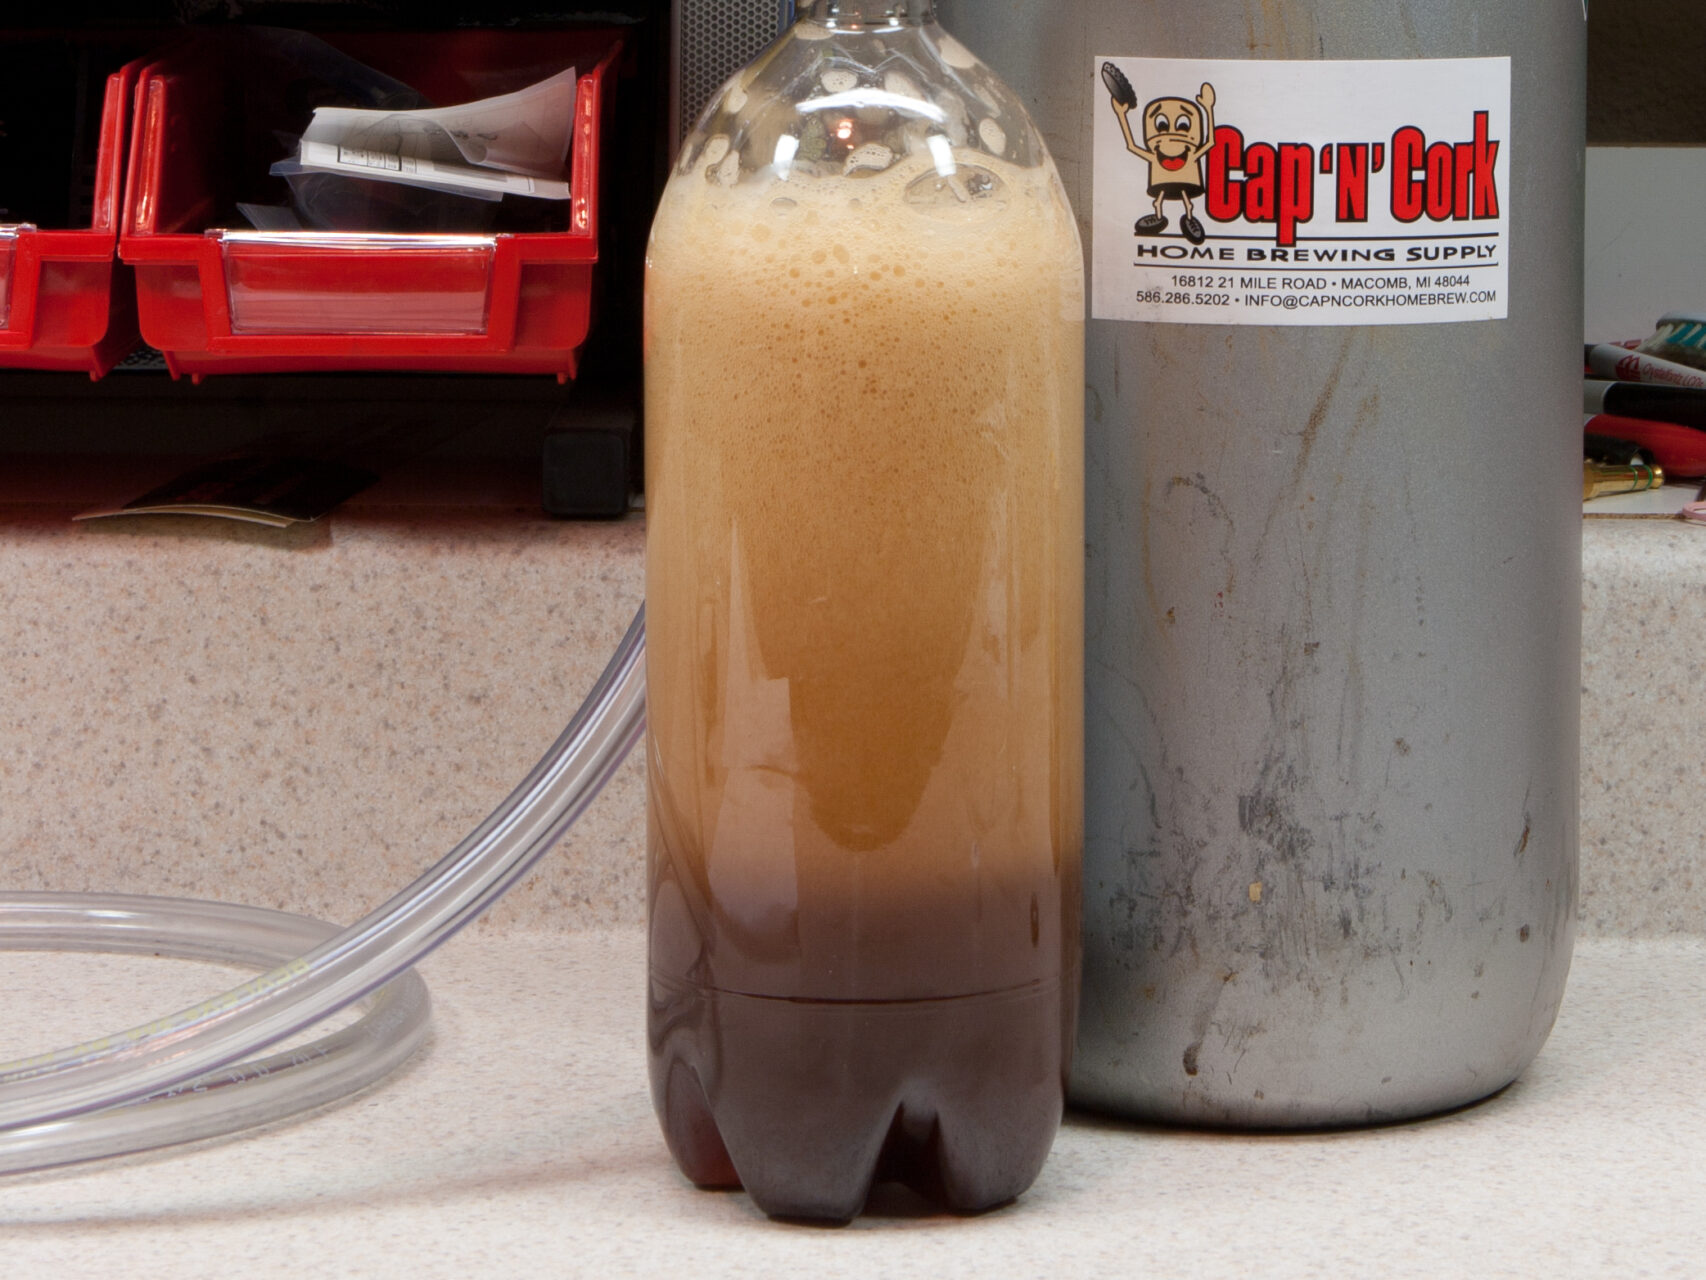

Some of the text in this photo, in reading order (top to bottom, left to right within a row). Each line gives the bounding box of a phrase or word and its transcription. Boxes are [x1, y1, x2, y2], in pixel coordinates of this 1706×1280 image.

[1205, 124, 1315, 248] Cap
[1390, 110, 1500, 223] Cork
[1137, 244, 1497, 262] HOME BREWING SUPPLY
[1171, 274, 1470, 291] 16812 21 MILE ROAD MACOMB, MI 48044
[1136, 290, 1497, 310] 586.286.5202 INFO@CAPNCORKHOMEBREW.COM
